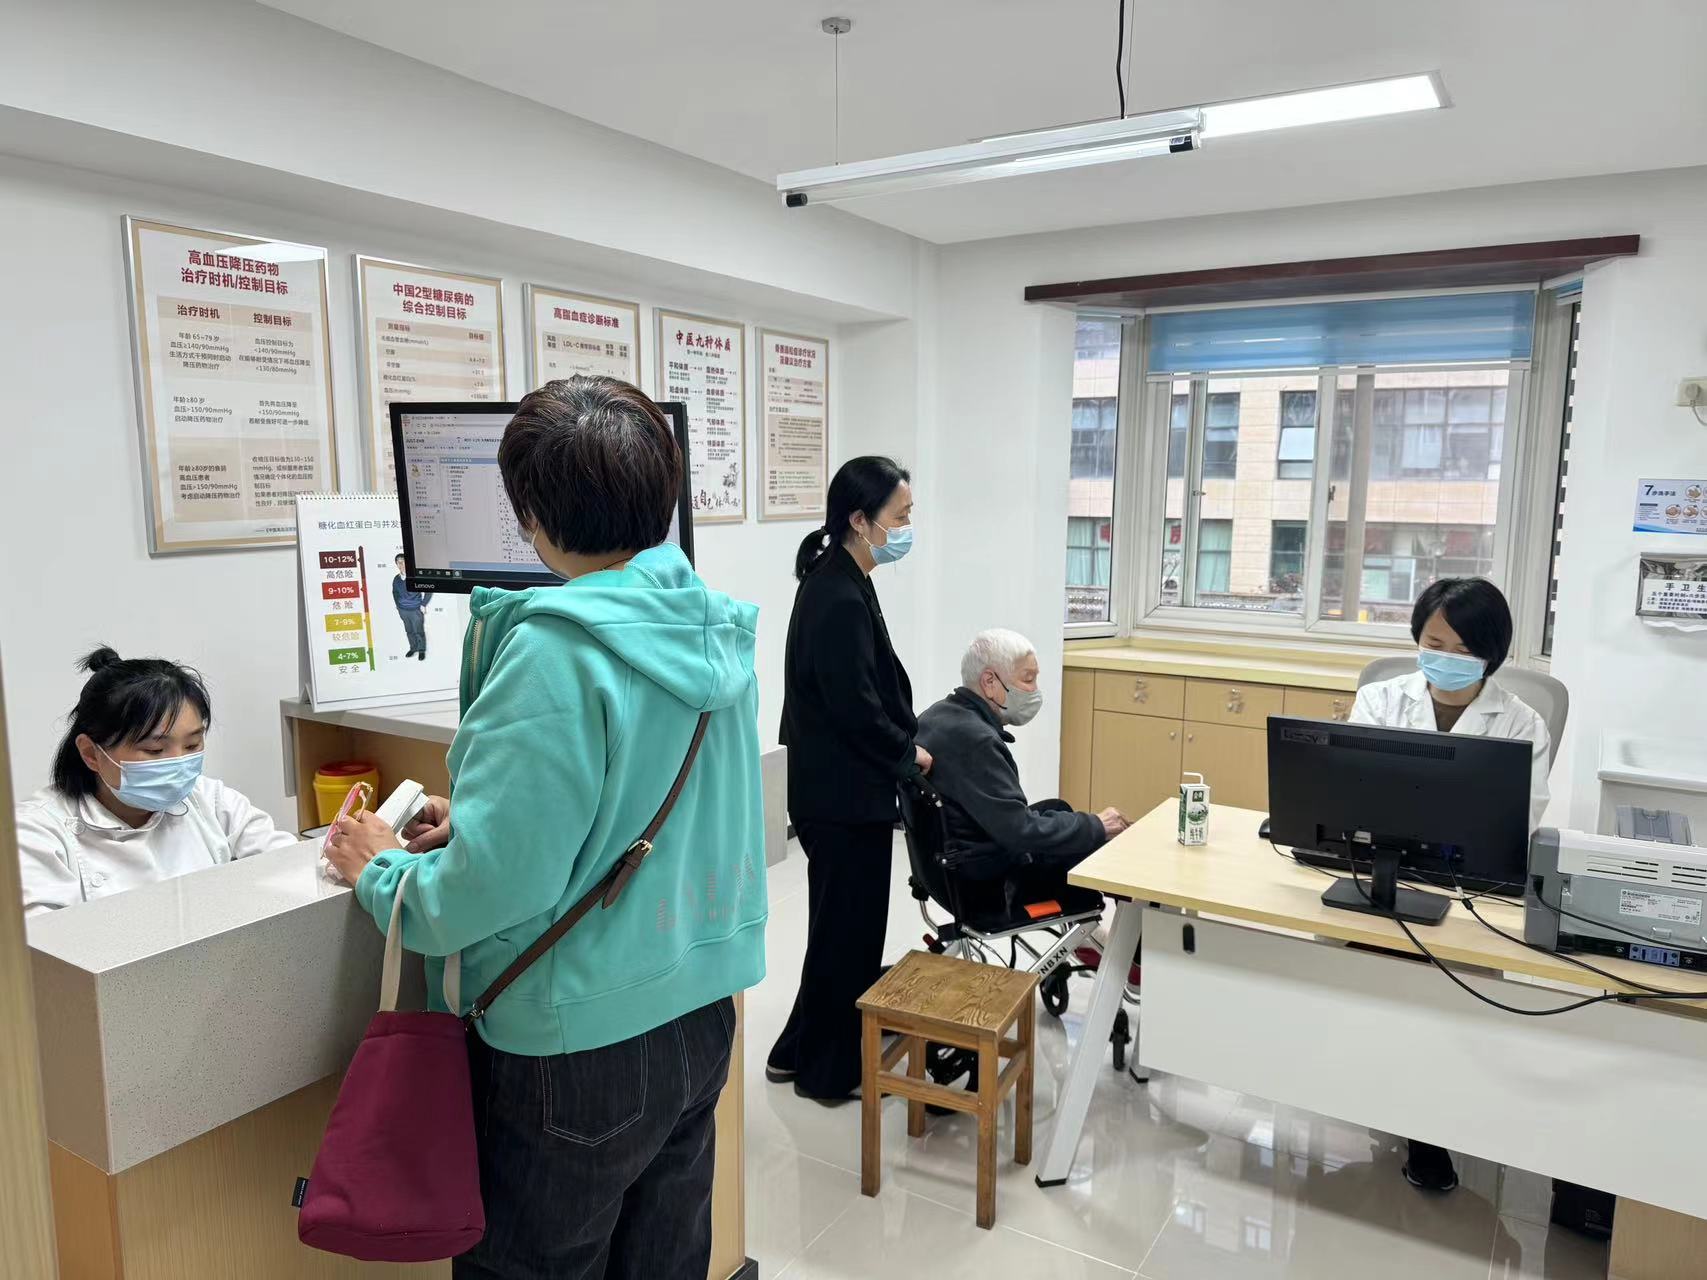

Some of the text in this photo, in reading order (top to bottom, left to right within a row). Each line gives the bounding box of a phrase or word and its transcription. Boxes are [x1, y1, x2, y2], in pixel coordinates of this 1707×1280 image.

[188, 250, 280, 277] 高血压降压药物
[180, 267, 289, 295] 治疗时机/控制目标
[393, 282, 475, 306] 中国2型糖尿病的
[177, 304, 220, 320] 治疗时机
[402, 300, 467, 321] 综合控制目标
[553, 307, 620, 328] 高脂血症诊断标准
[253, 312, 292, 327] 控制目标
[676, 330, 731, 352] 中医九种体质
[318, 520, 403, 530] 糖化血红蛋白与并发
[323, 555, 355, 564] 10-12%
[326, 569, 353, 579] 高危险
[327, 587, 355, 595] 9-10%
[334, 618, 355, 626] 7-9%
[332, 631, 360, 642] 较危险
[337, 652, 359, 660] 4-7%
